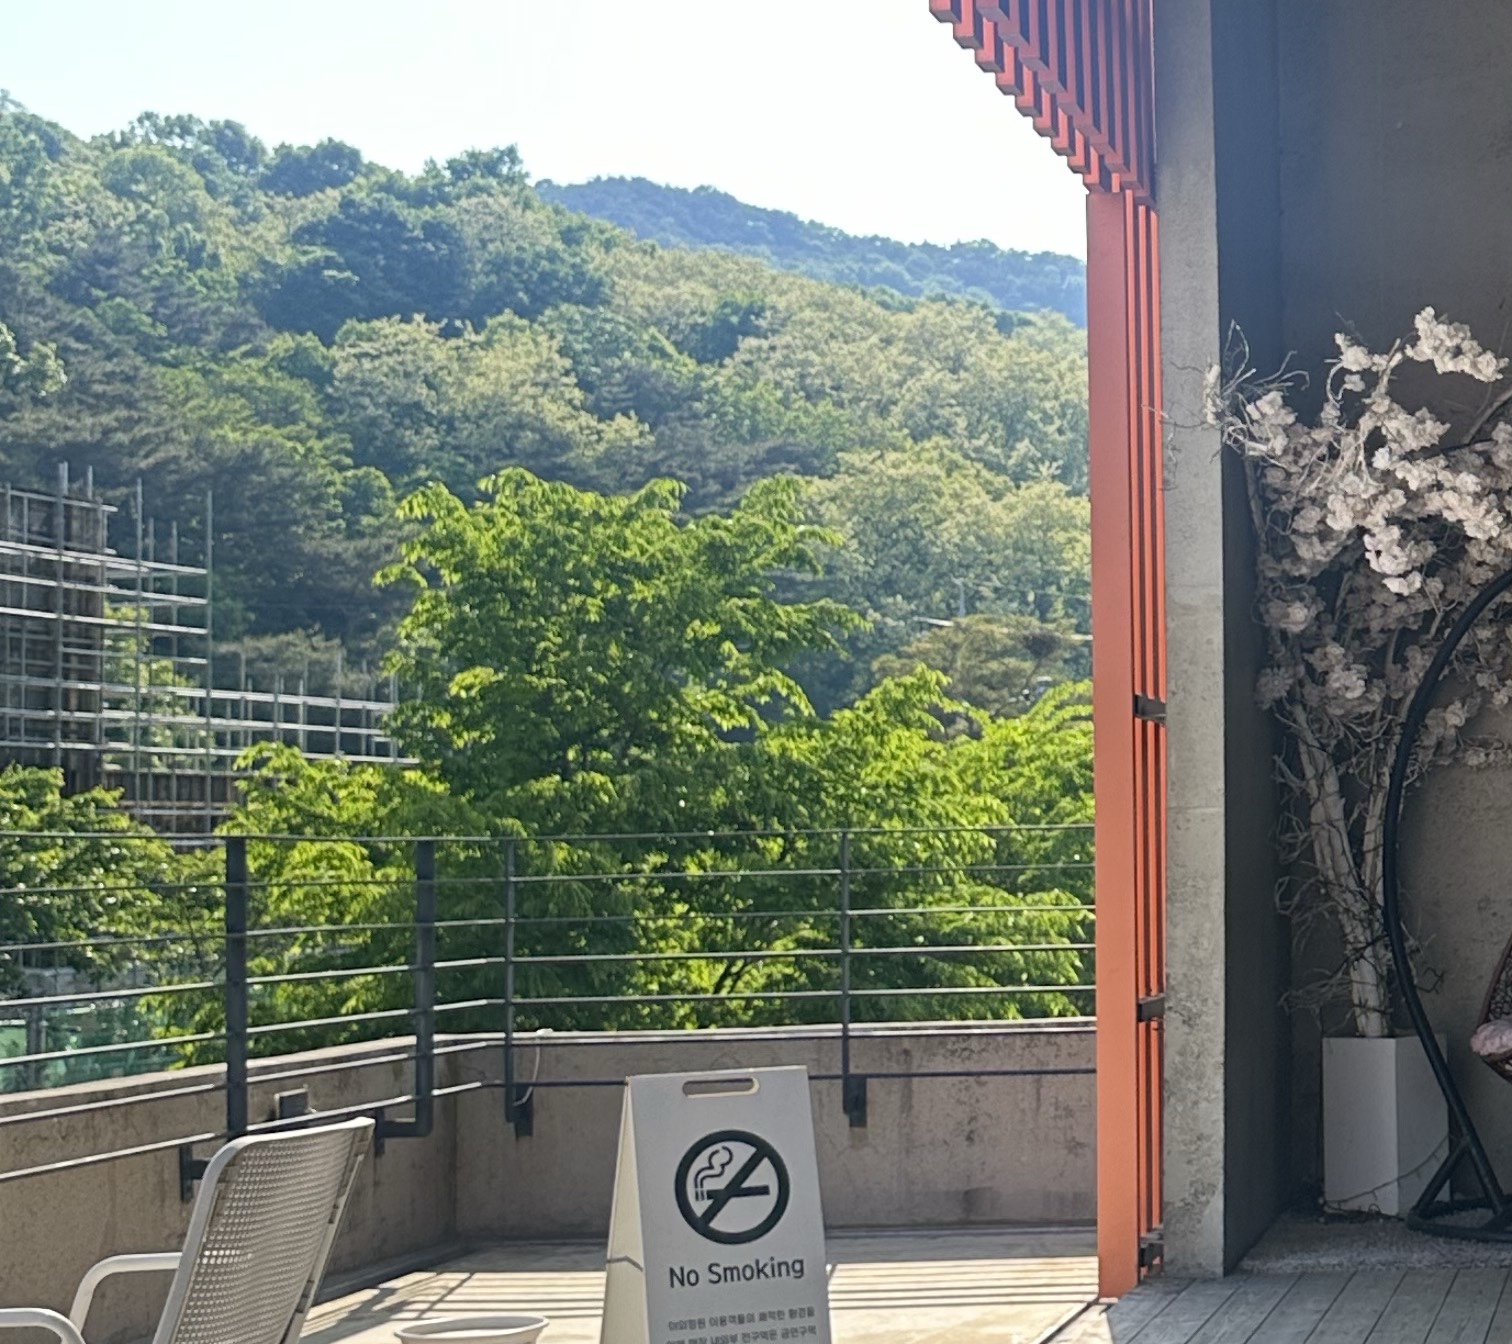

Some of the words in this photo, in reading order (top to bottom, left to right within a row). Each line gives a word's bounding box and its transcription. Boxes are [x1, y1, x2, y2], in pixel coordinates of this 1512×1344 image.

[668, 1266, 700, 1288] No
[708, 1256, 805, 1284] Smoking
[741, 1330, 778, 1343] 전구역은
[781, 1325, 817, 1339] 금연구역
